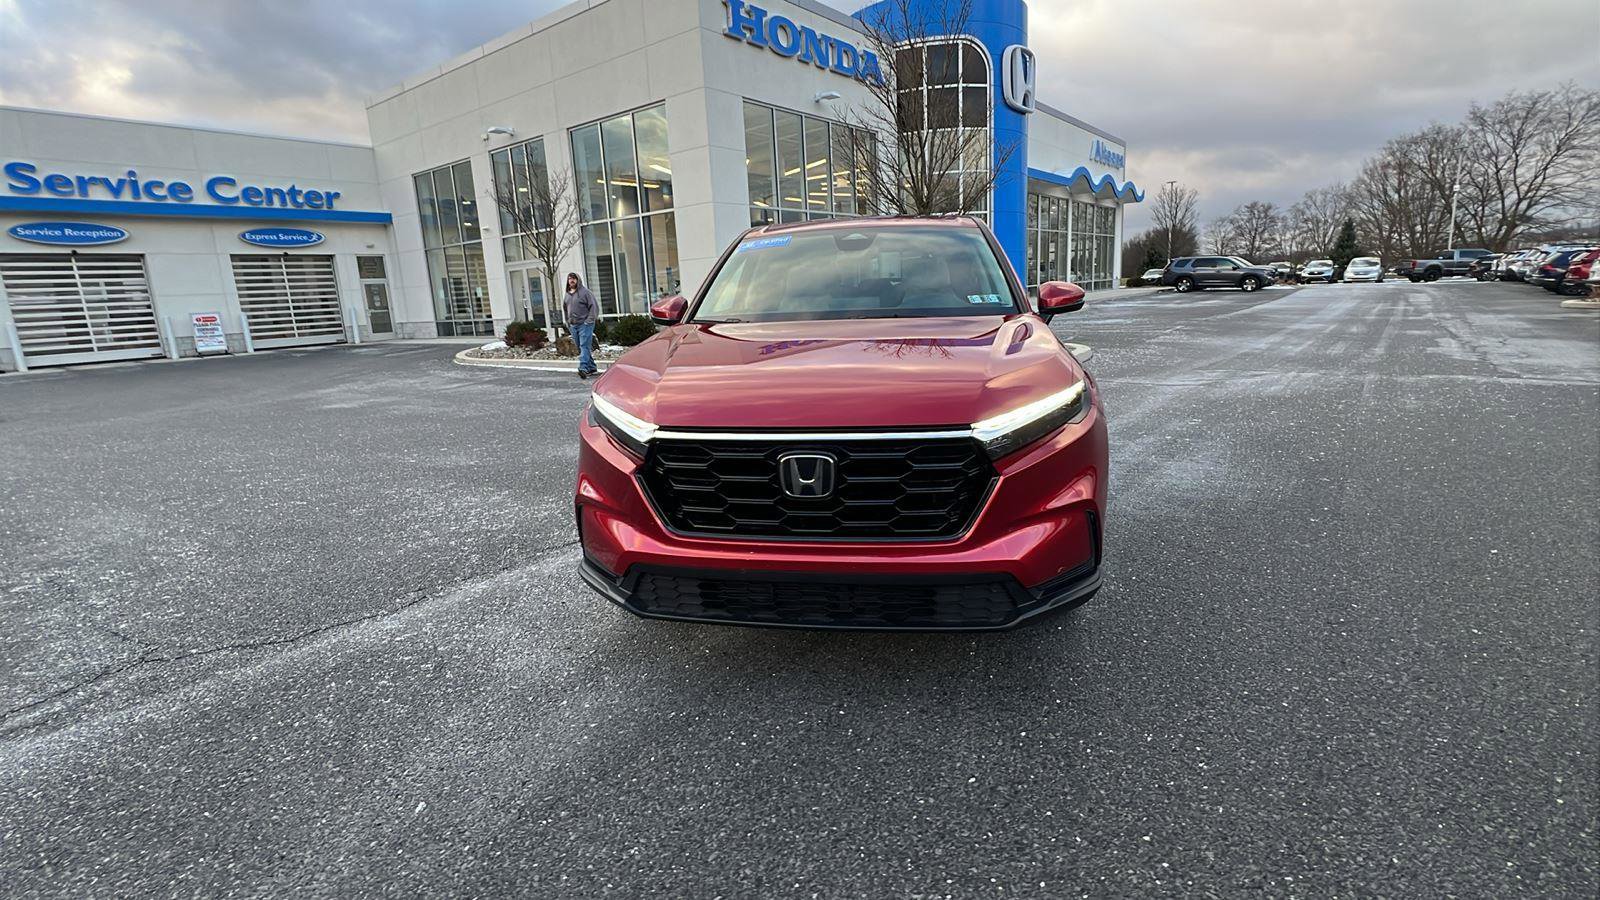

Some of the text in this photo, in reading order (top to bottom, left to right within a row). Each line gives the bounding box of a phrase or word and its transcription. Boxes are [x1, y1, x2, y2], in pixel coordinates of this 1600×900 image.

[723, 0, 886, 88] HONDA
[4, 162, 341, 209] Service Center
[16, 227, 121, 238] Service Reception
[245, 233, 309, 241] Express Service
